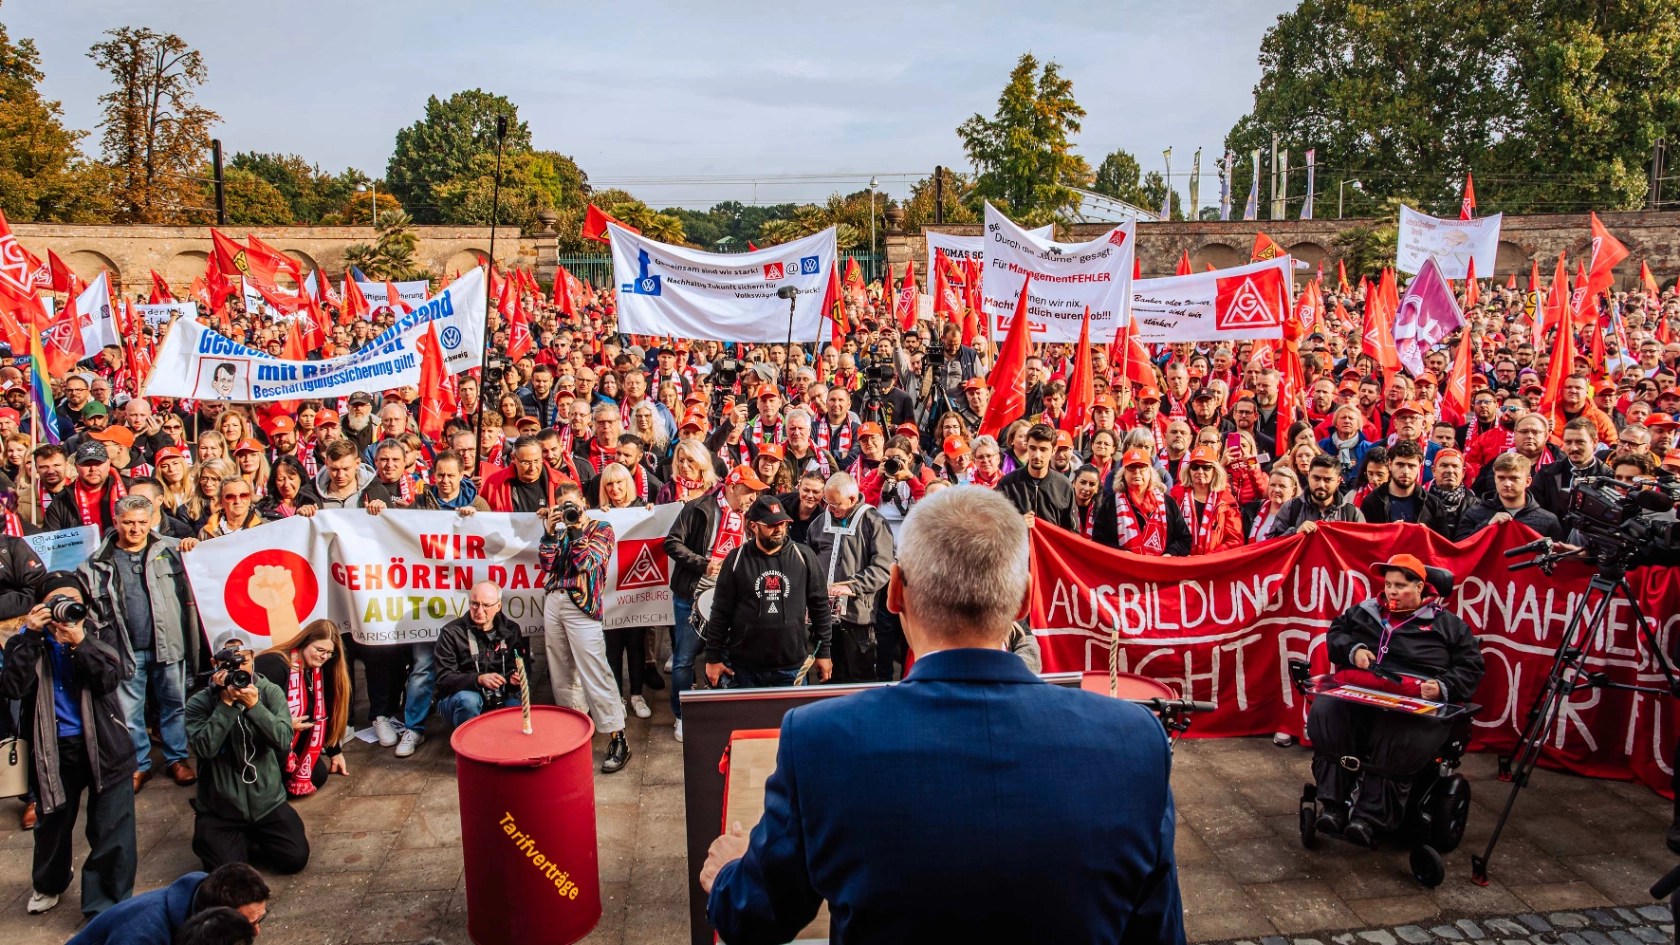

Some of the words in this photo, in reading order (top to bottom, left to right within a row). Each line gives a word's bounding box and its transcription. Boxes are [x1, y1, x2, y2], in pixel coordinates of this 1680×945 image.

[994, 232, 1021, 250] Durch
[1022, 246, 1035, 255] die
[701, 267, 718, 275] sind
[734, 267, 759, 275] stark!
[992, 258, 1008, 269] Für
[667, 277, 707, 289] Nachhaltig
[707, 282, 737, 291] Zukunft
[765, 281, 777, 290] für
[984, 296, 1015, 311] Macht
[1054, 312, 1084, 321] euren
[1089, 310, 1111, 321] ob!!!
[1014, 290, 1047, 307] knen
[1048, 298, 1065, 308] wir
[1065, 298, 1083, 309] nix.
[1133, 294, 1162, 305] Banker
[1164, 299, 1182, 307] oder
[1143, 318, 1178, 329] stärker!
[1168, 309, 1187, 317] sind
[1188, 311, 1202, 319] wir
[199, 328, 277, 359] Gesu
[253, 359, 393, 399] Beschäftigungssicherung
[394, 352, 416, 373] gilt!
[257, 363, 298, 382] mit
[421, 533, 486, 560] WIR
[331, 556, 474, 591] GEHÖREN
[487, 564, 548, 590] DAZ
[617, 590, 669, 606] WOLFSBURG
[363, 595, 545, 623] AUTOVON
[1048, 573, 1285, 635] AUSBILDUNG
[1293, 563, 1372, 615] UND
[1452, 575, 1640, 658] RNAHME
[601, 612, 667, 626] LIDARISCH
[499, 811, 579, 901] Tarifverträge
